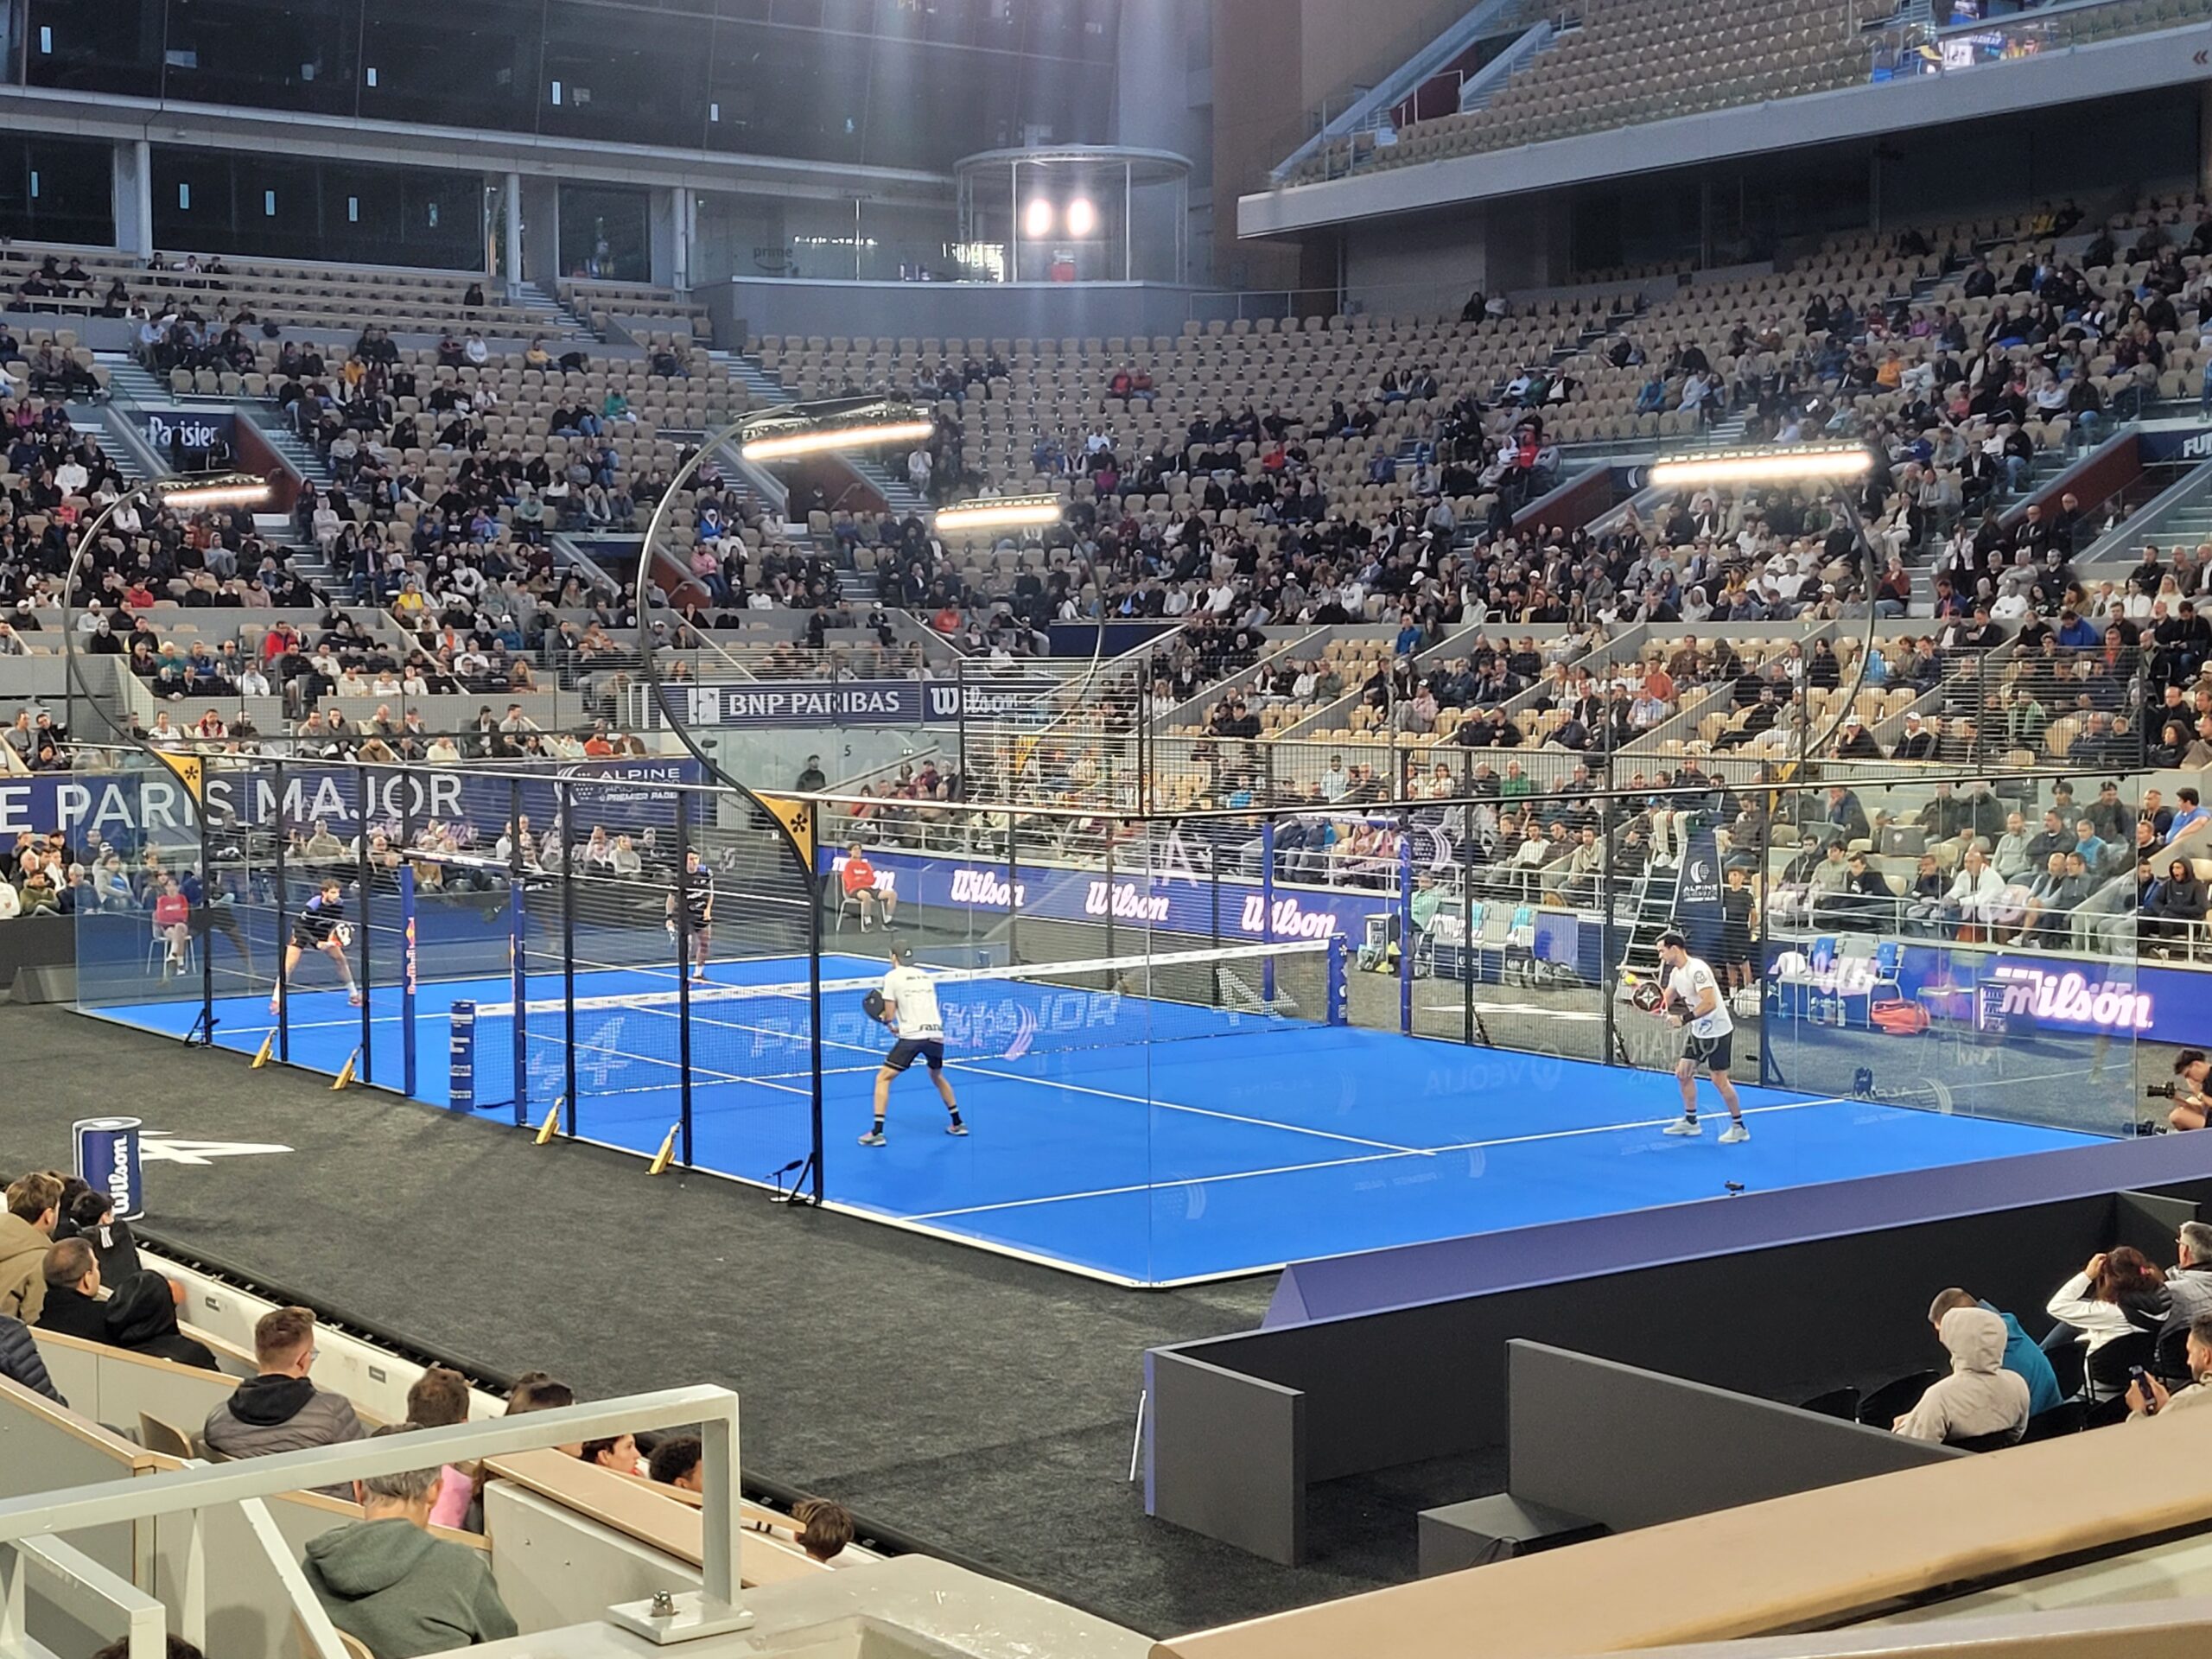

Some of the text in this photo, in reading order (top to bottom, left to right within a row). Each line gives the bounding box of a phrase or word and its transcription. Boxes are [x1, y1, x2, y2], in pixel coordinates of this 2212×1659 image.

[729, 690, 900, 715] BNP PARIBAS
[844, 745, 851, 757] 5
[601, 768, 680, 779] ALPINE
[57, 778, 234, 830] PARIS
[257, 773, 463, 823] MAJOR
[951, 869, 1024, 906] Wilson
[1085, 881, 1169, 921] Wilson
[1242, 895, 1337, 938] Wilson
[108, 1135, 129, 1214] Wilson
